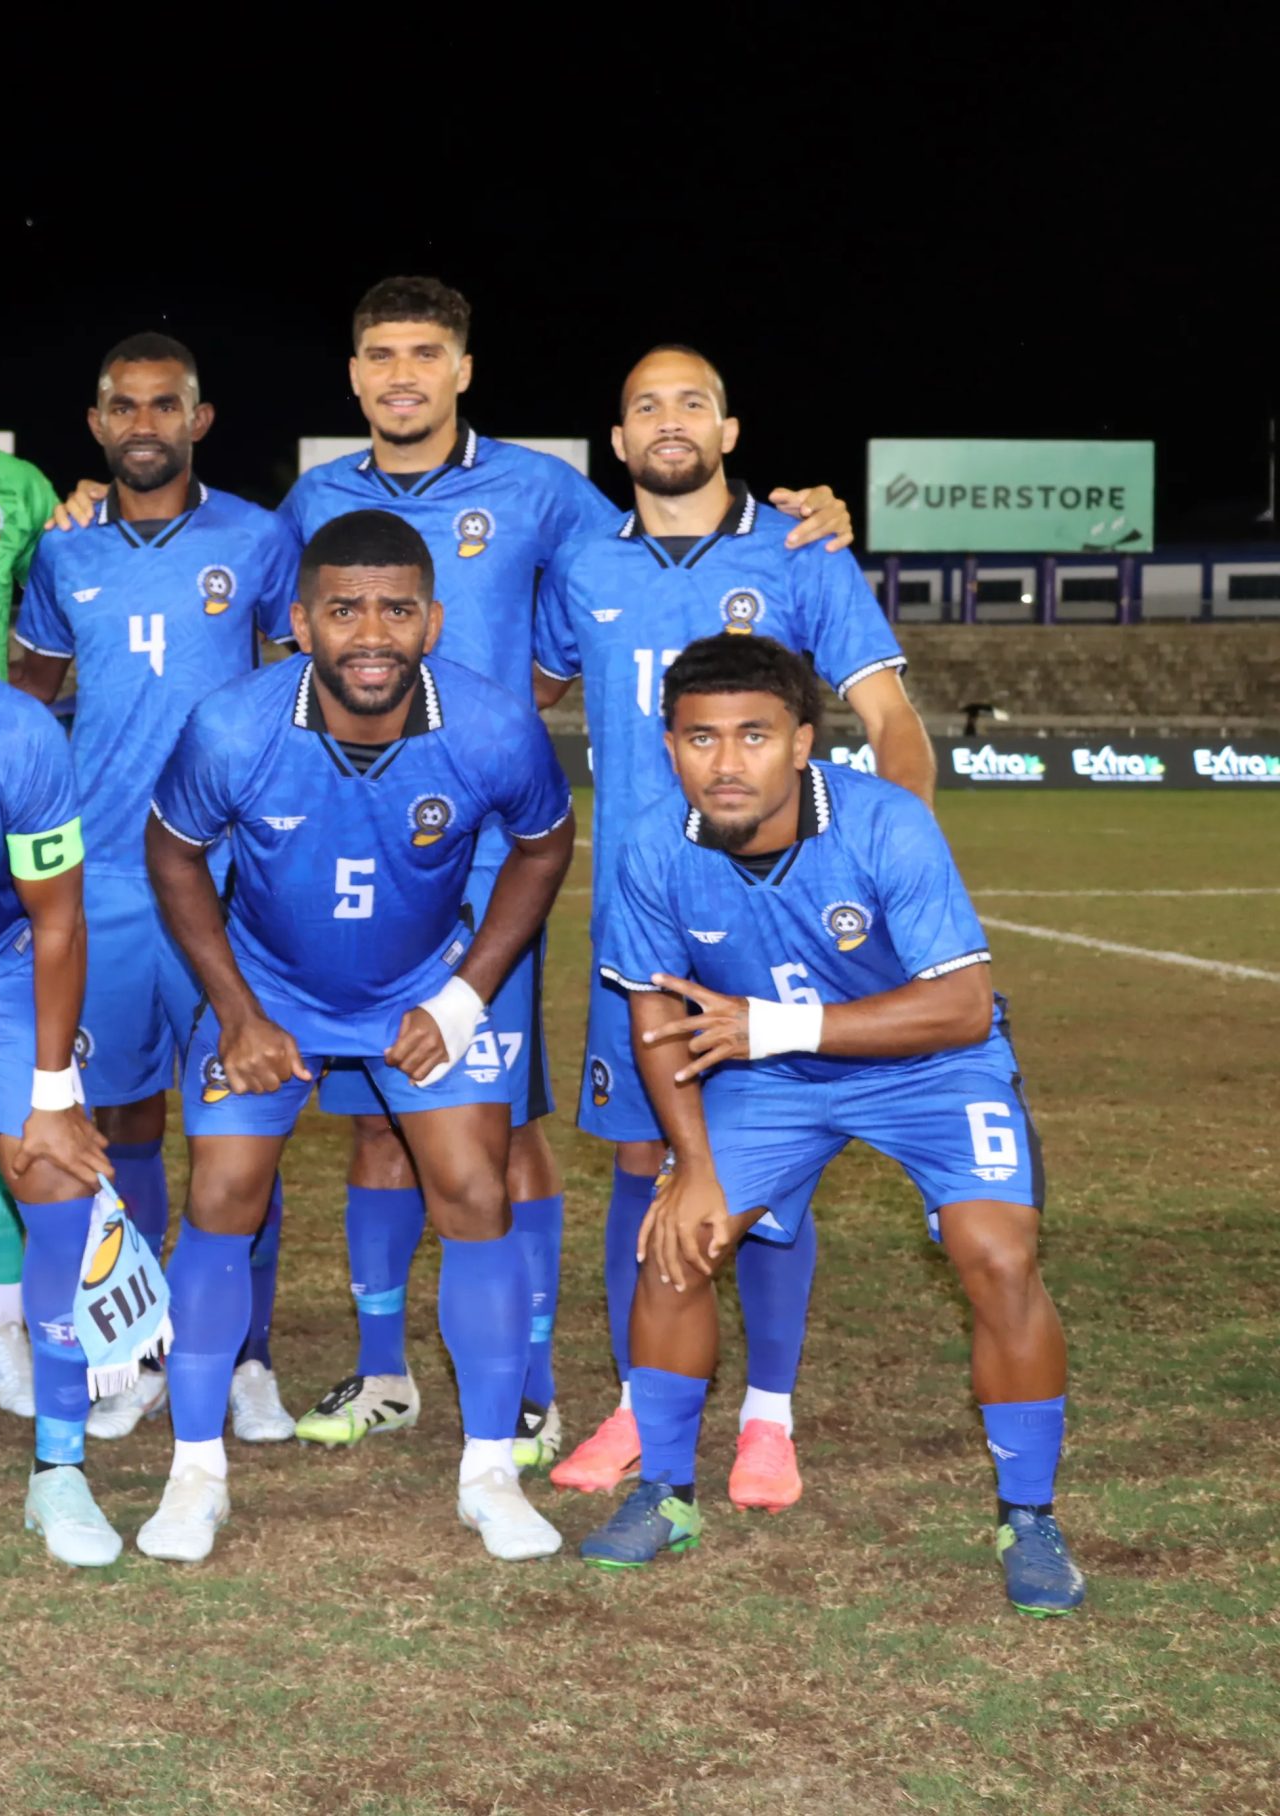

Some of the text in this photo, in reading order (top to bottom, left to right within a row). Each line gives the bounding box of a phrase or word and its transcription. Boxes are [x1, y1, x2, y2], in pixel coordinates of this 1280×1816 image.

[885, 473, 1125, 510] SUPERSTORE
[128, 613, 167, 677] 4
[952, 745, 1025, 775] Extra
[1072, 745, 1146, 775] Extra
[1193, 745, 1267, 775] Extra
[32, 833, 64, 871] C
[333, 857, 376, 919] 5
[965, 1101, 1019, 1167] 6
[87, 1264, 157, 1344] FIJI
